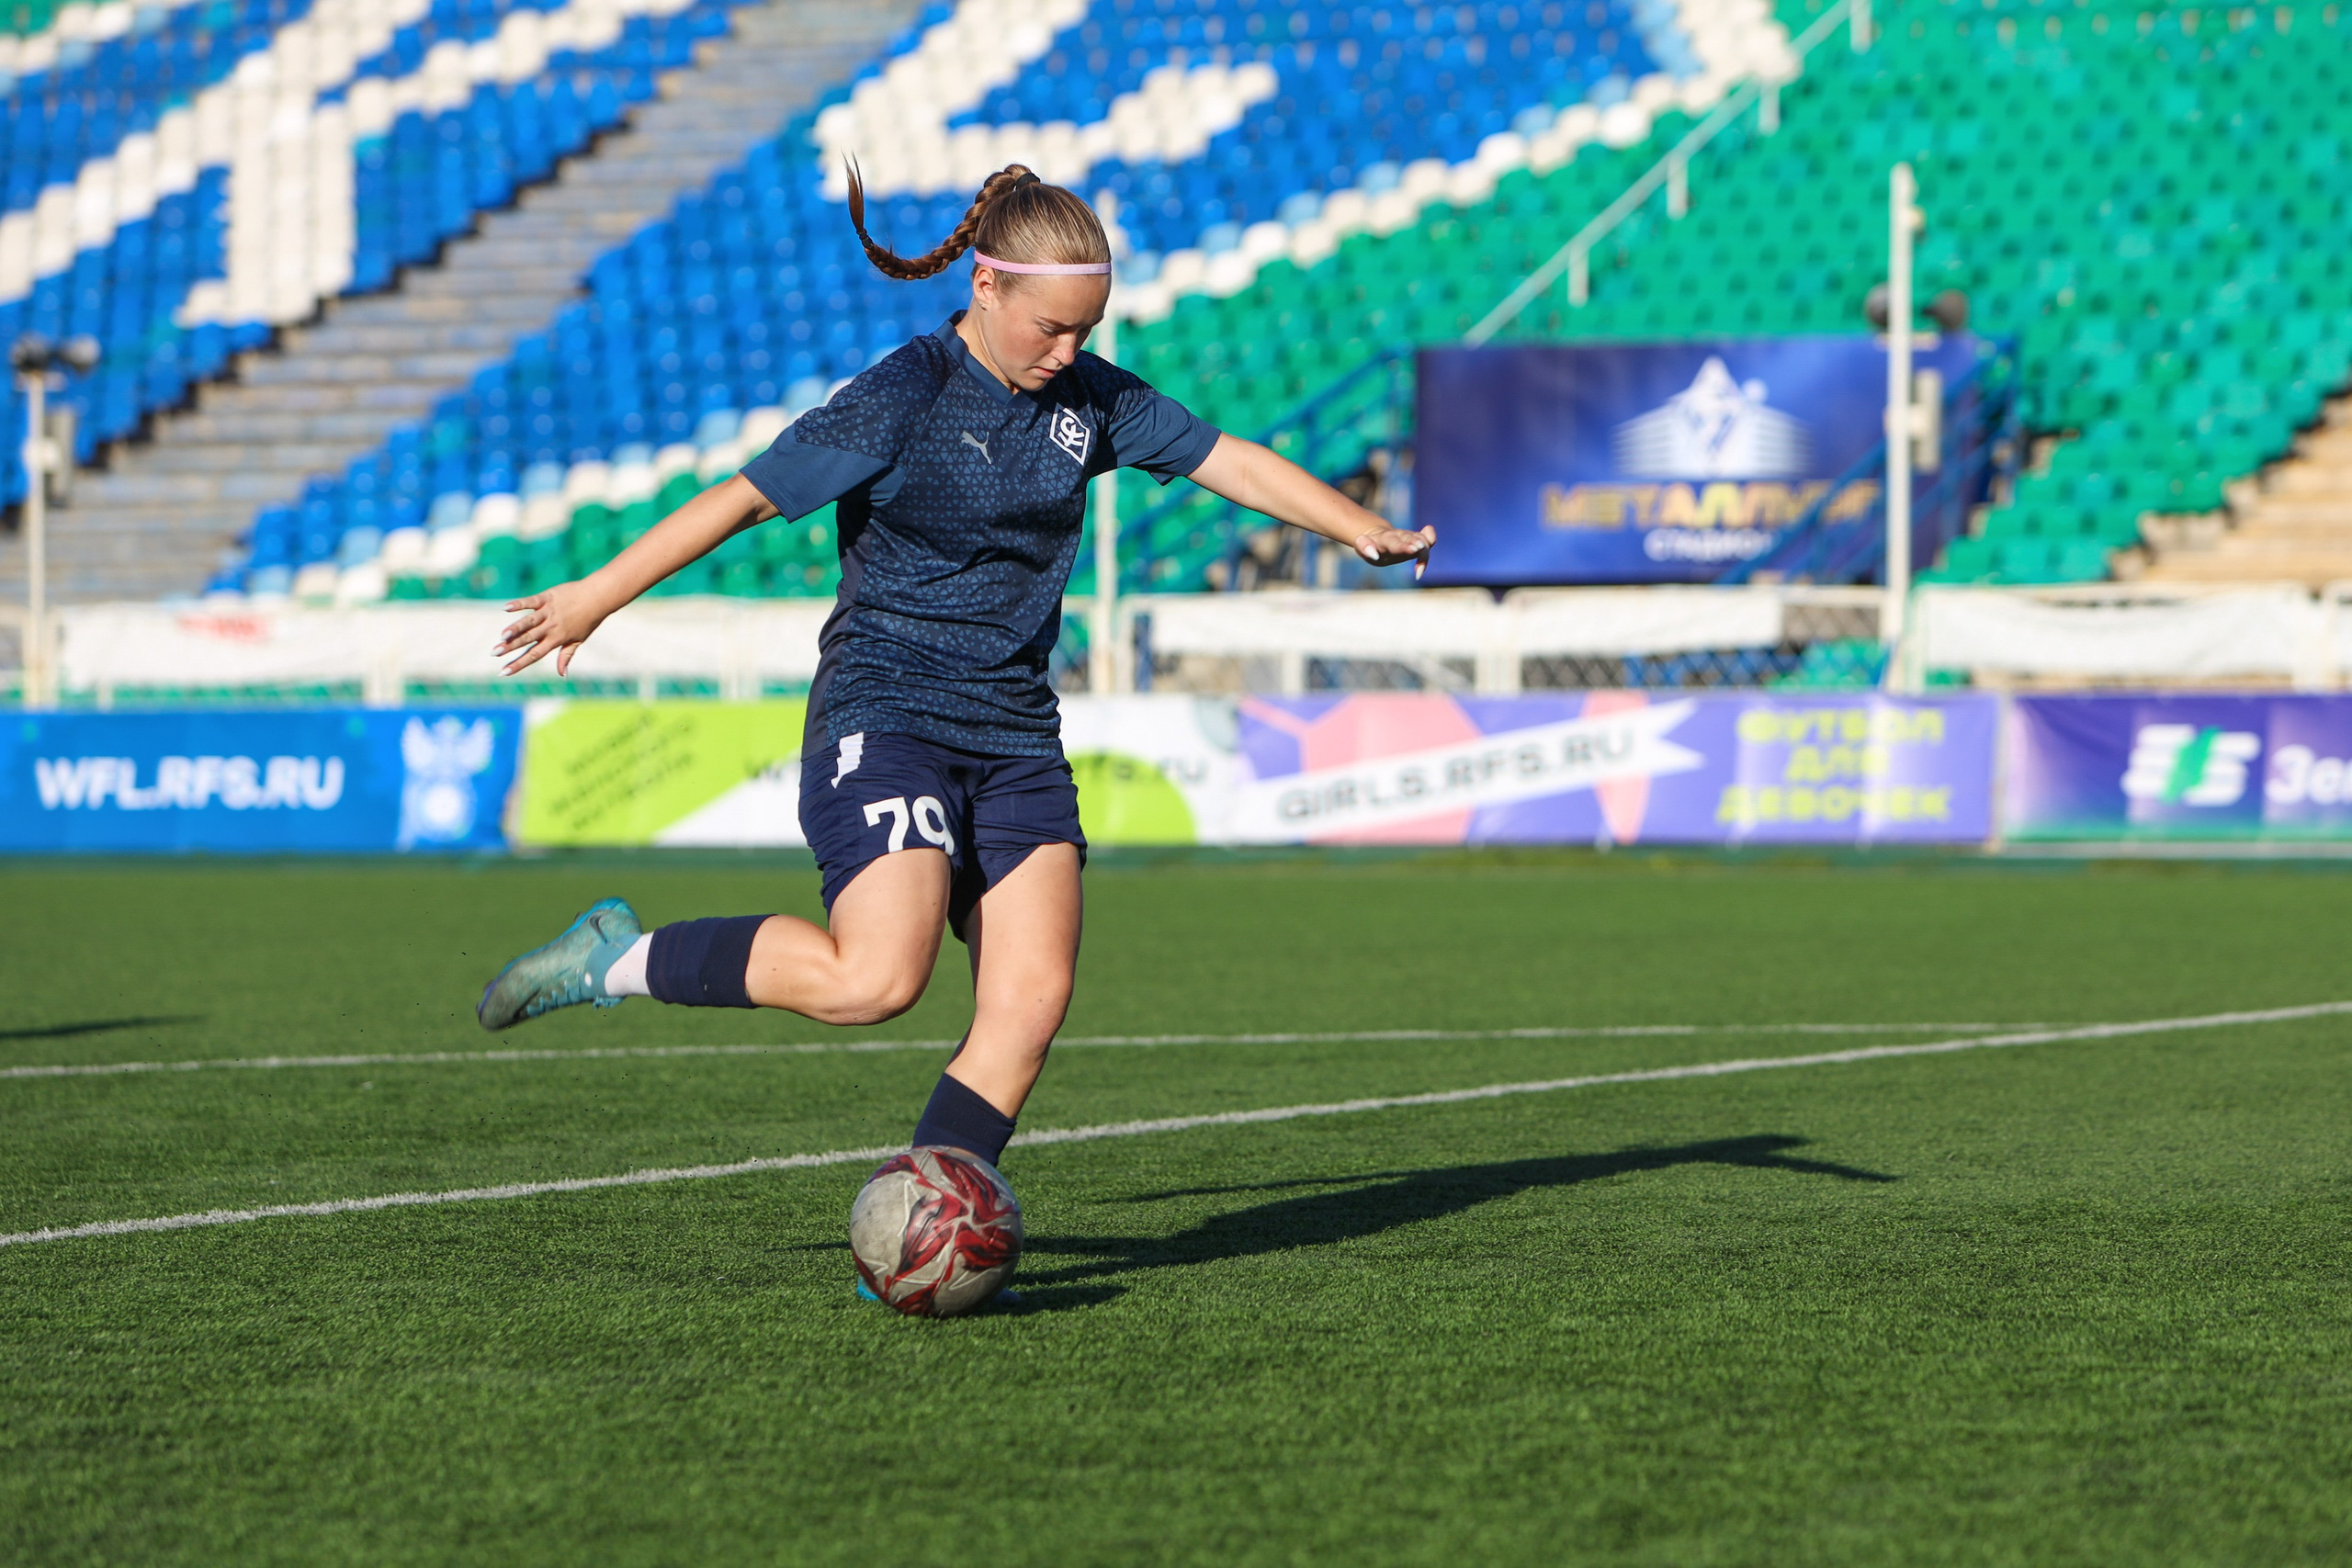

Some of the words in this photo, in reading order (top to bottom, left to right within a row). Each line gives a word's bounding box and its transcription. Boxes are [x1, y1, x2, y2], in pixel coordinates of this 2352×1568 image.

[1737, 710, 1944, 744] ФУТБОЛ
[35, 755, 345, 810] WFL.RFS.RU
[1277, 728, 1635, 824] GIRLS.RFS.RU
[1786, 746, 1888, 781] ДЛЯ
[2264, 744, 2352, 805] Зе
[863, 795, 955, 856] 79
[1715, 786, 1952, 823] ДЕВОЧЕК
